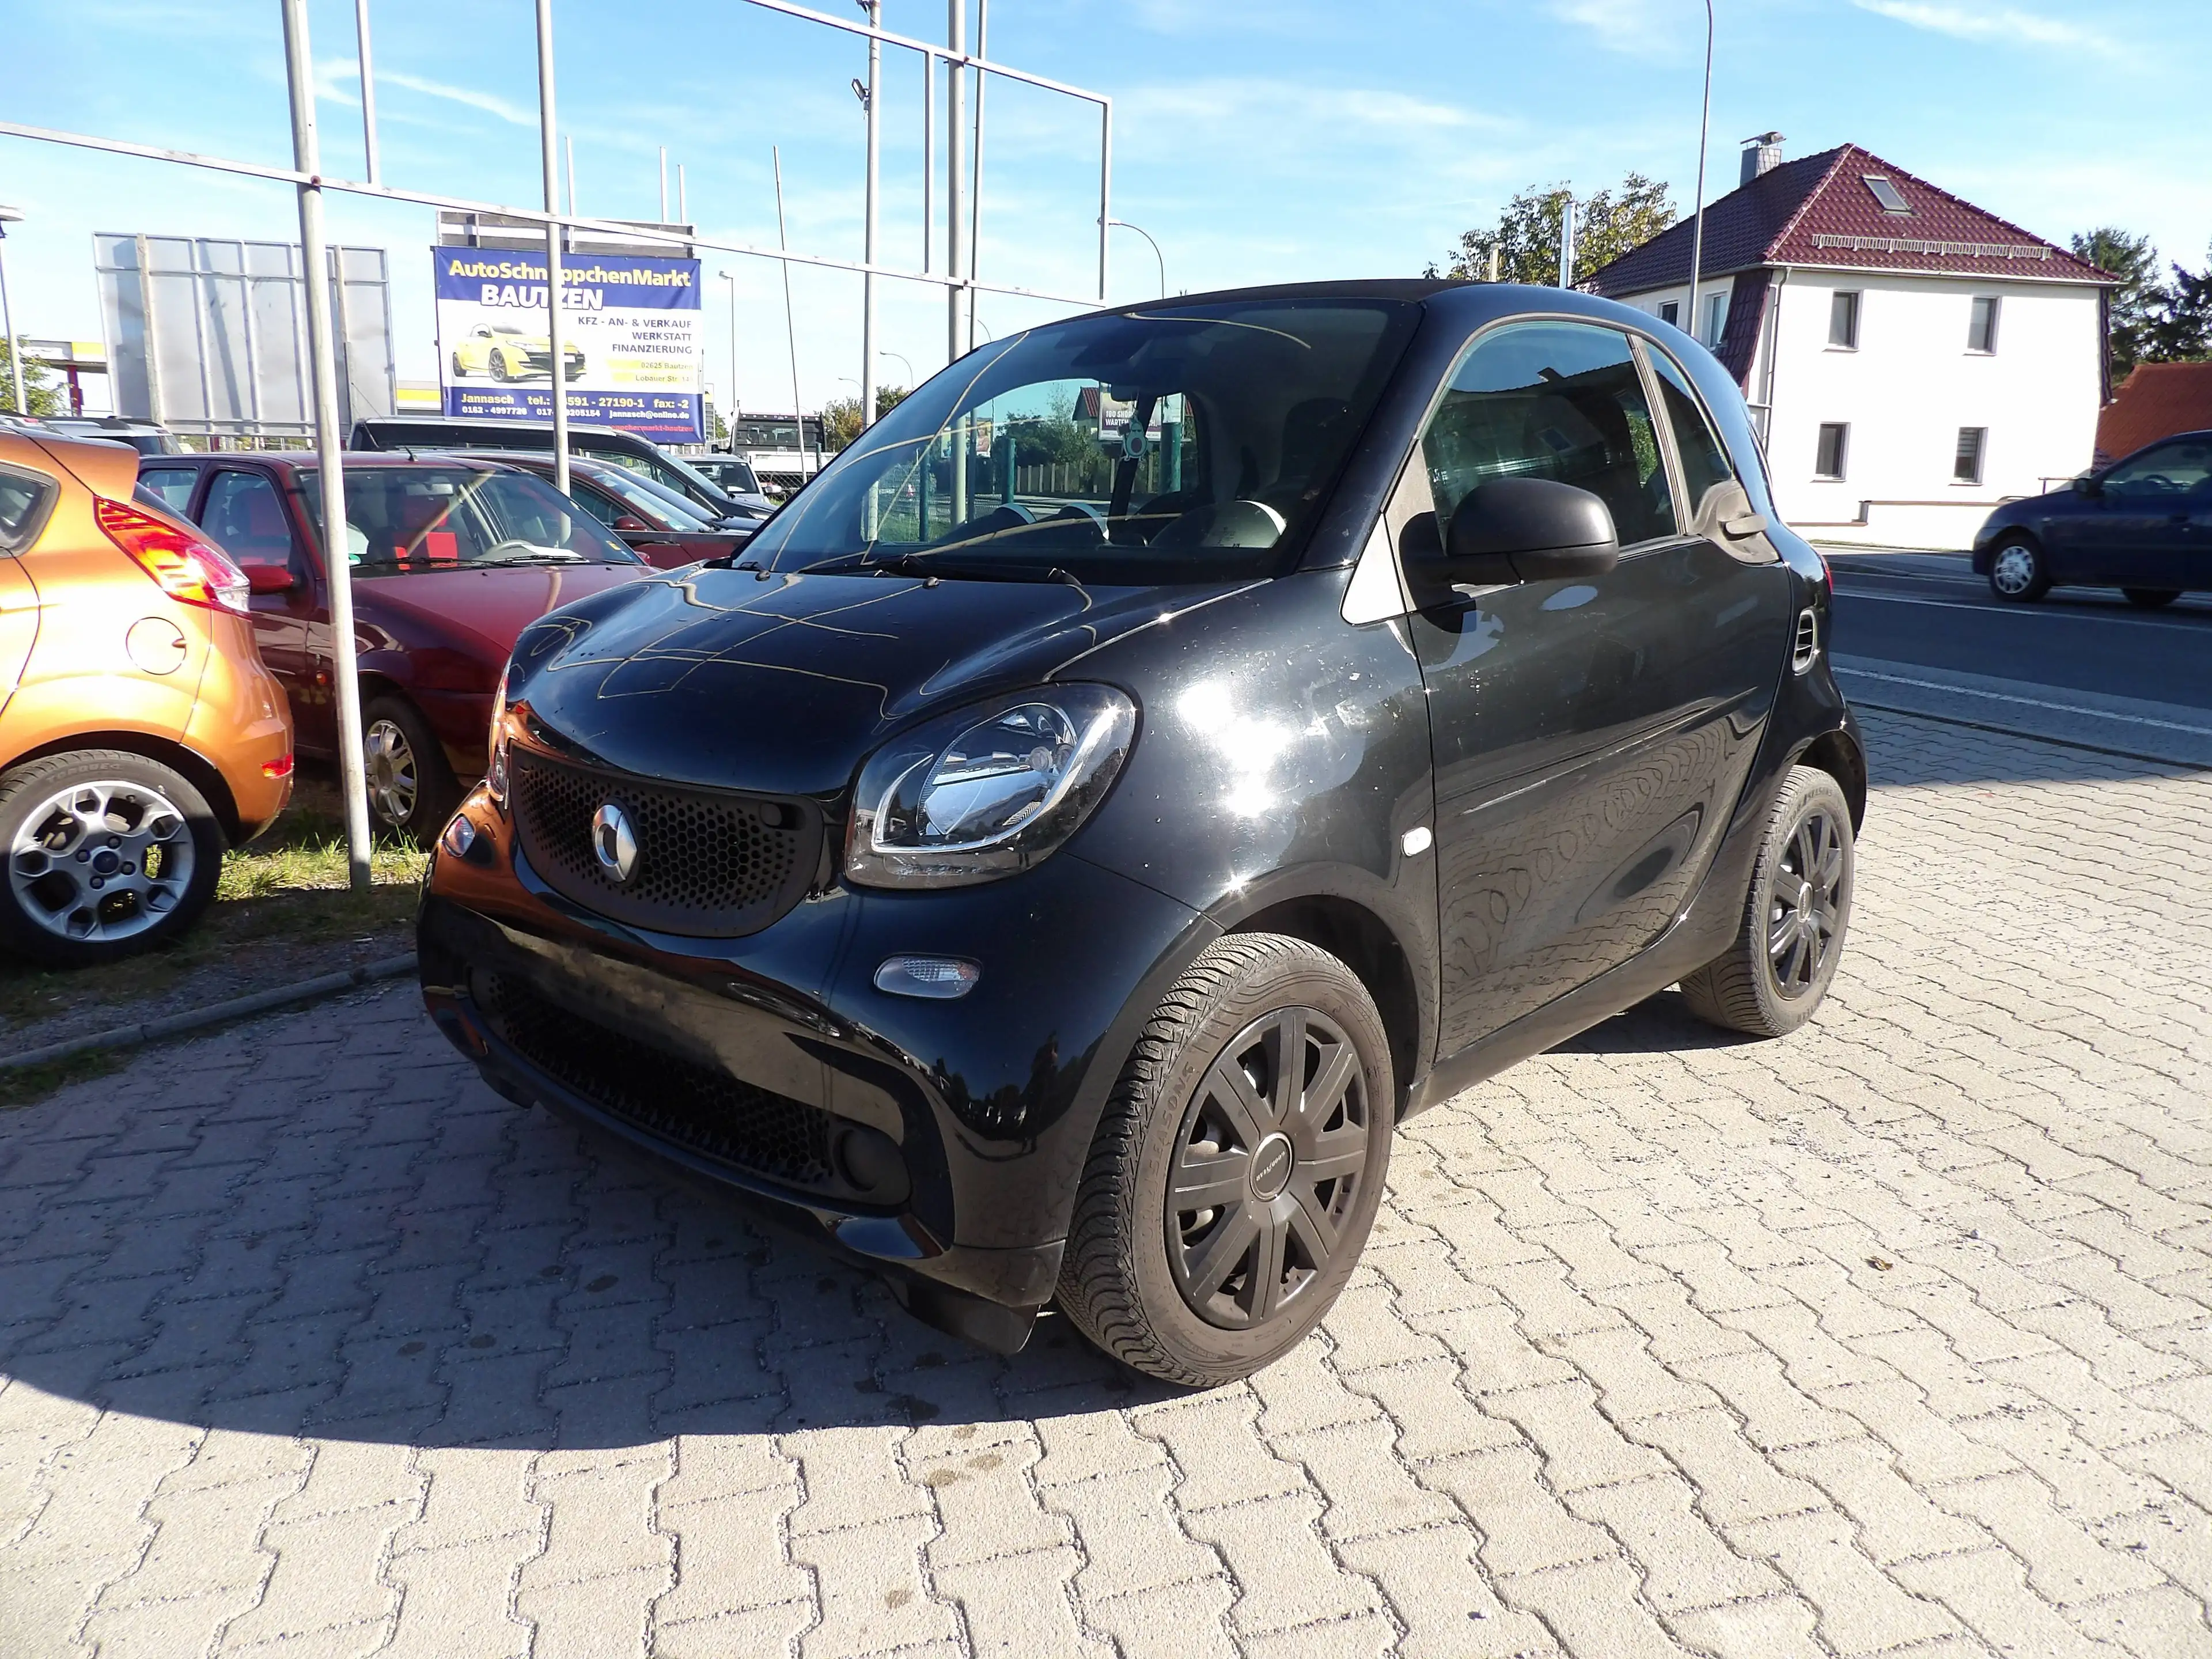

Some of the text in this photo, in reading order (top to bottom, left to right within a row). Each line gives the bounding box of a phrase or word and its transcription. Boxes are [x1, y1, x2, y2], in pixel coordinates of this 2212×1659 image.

[449, 260, 691, 287] AutoSchnppchenMarkt
[578, 317, 597, 325] KFZ
[608, 318, 628, 326] AN-
[632, 319, 639, 327] &
[643, 319, 692, 328] VERKAUF
[632, 332, 692, 341] WERKSTATT
[612, 344, 692, 354] FINANZIERUNG
[461, 393, 514, 404] Jannasch
[527, 396, 551, 406] tel.:
[566, 396, 589, 406] 591
[599, 397, 645, 408] 27190-1
[653, 398, 675, 408] fax:
[677, 399, 690, 408] -2
[536, 408, 554, 416] 017
[609, 410, 690, 419] jannasch@online.de
[1256, 1150, 1286, 1181] GOODYEAR
